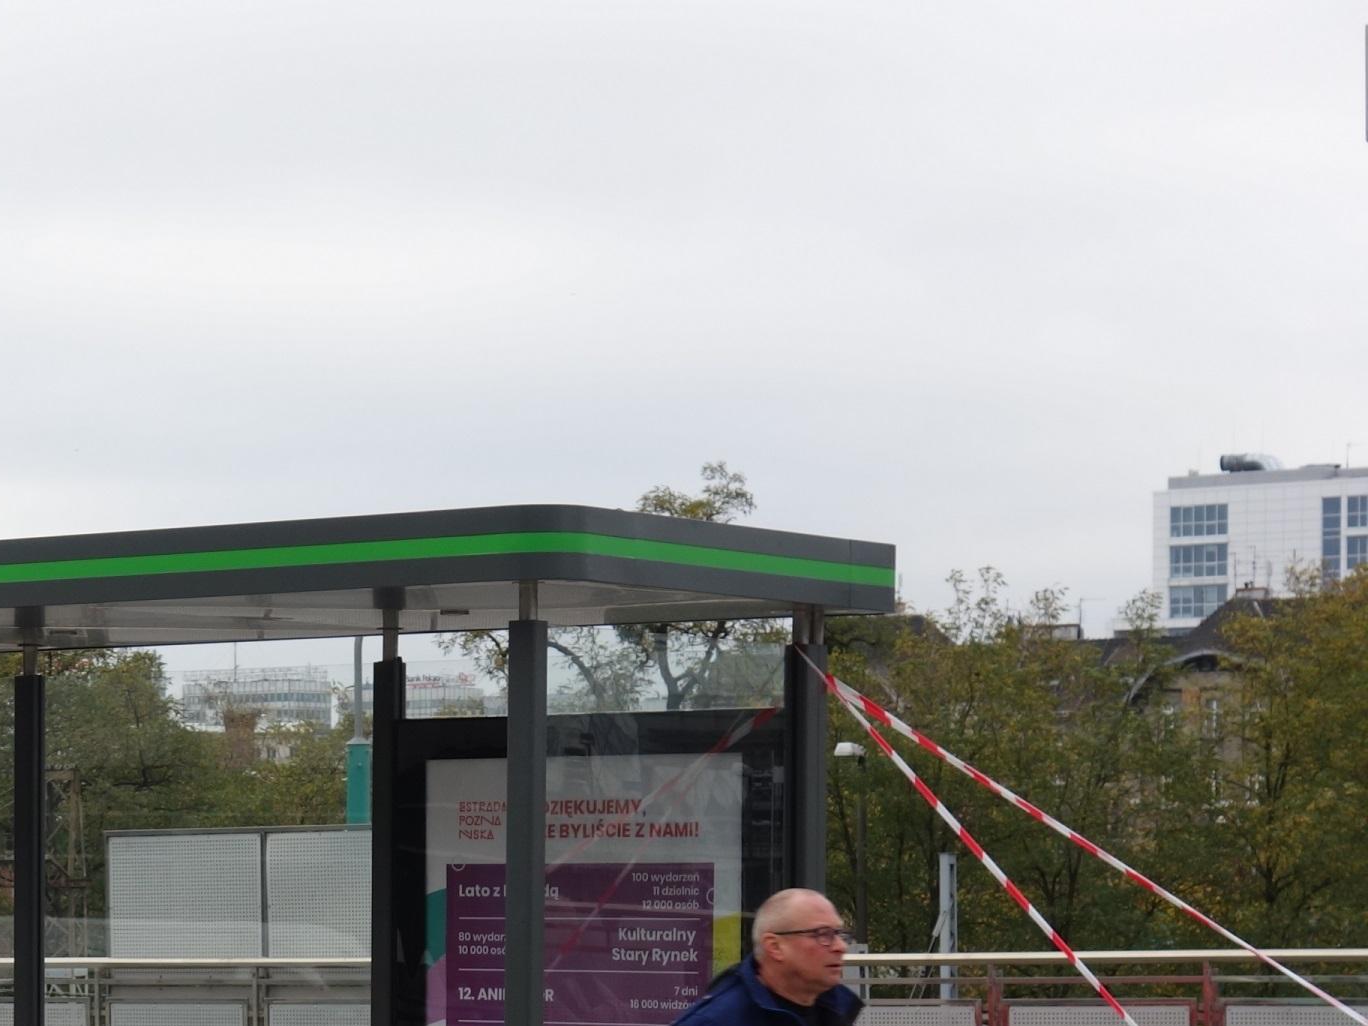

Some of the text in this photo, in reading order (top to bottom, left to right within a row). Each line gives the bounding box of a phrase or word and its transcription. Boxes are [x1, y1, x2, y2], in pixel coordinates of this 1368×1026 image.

[559, 818, 632, 838] BYLIŚCIE
[634, 822, 645, 838] Z
[648, 822, 699, 838] NAMI!
[632, 872, 649, 882] 100
[458, 884, 490, 897] Lato
[492, 886, 501, 897] z
[642, 899, 700, 911] 12 000 osób
[458, 931, 506, 944] 80 wydar
[618, 927, 697, 946] Kulturalny
[458, 945, 468, 955] 10
[469, 945, 489, 955] 000
[612, 947, 698, 966] Stary Rynek
[457, 987, 475, 1000] 12.
[673, 985, 698, 996] 7 dni
[641, 999, 659, 1009] 000
